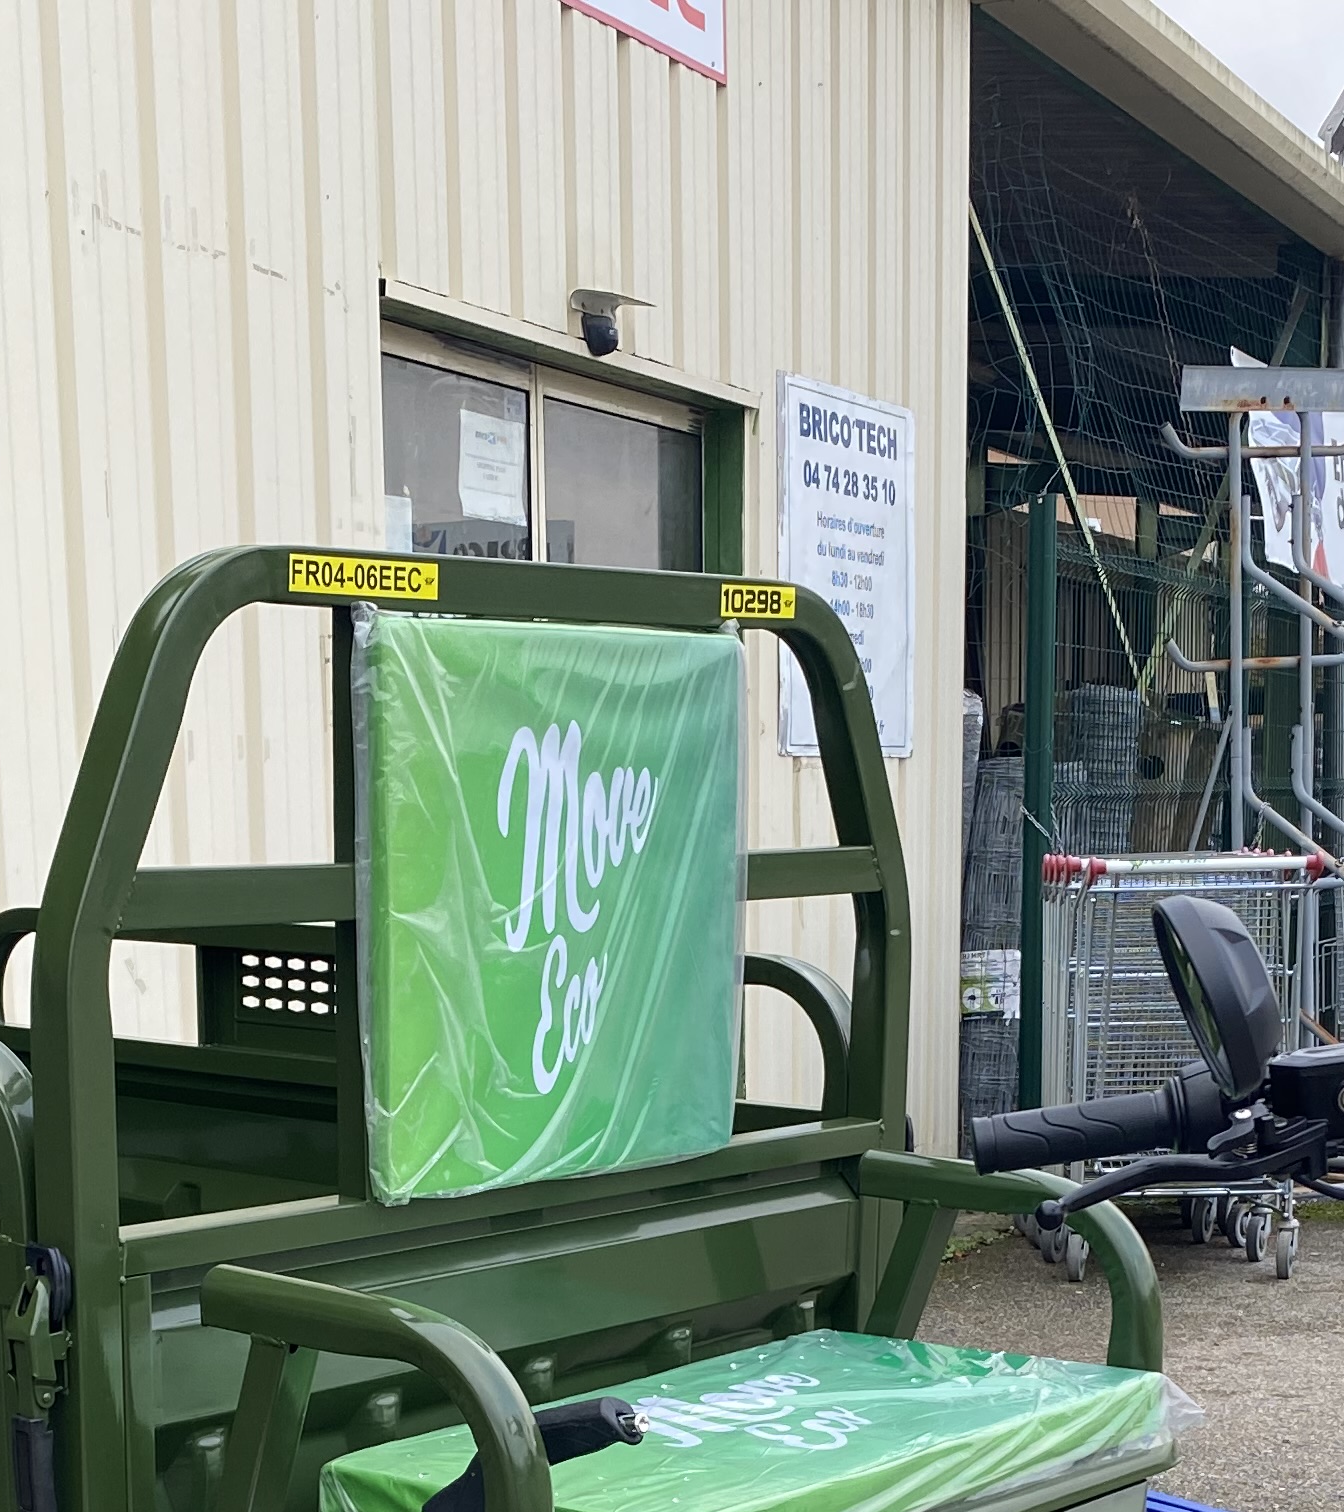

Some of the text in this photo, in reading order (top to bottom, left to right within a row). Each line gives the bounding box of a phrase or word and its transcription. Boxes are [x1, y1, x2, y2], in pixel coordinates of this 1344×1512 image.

[803, 459, 896, 507] 04 74 28 35 10
[816, 510, 846, 532] Horaires
[817, 541, 884, 567] du lundi au vendredi
[291, 559, 422, 593] FR04-06EEC
[831, 570, 848, 588] 8h30
[723, 588, 781, 615] 10298
[497, 718, 658, 953] Move
[531, 934, 608, 1095] Eco
[631, 1371, 820, 1448] Move
[743, 1405, 872, 1450] Eco
